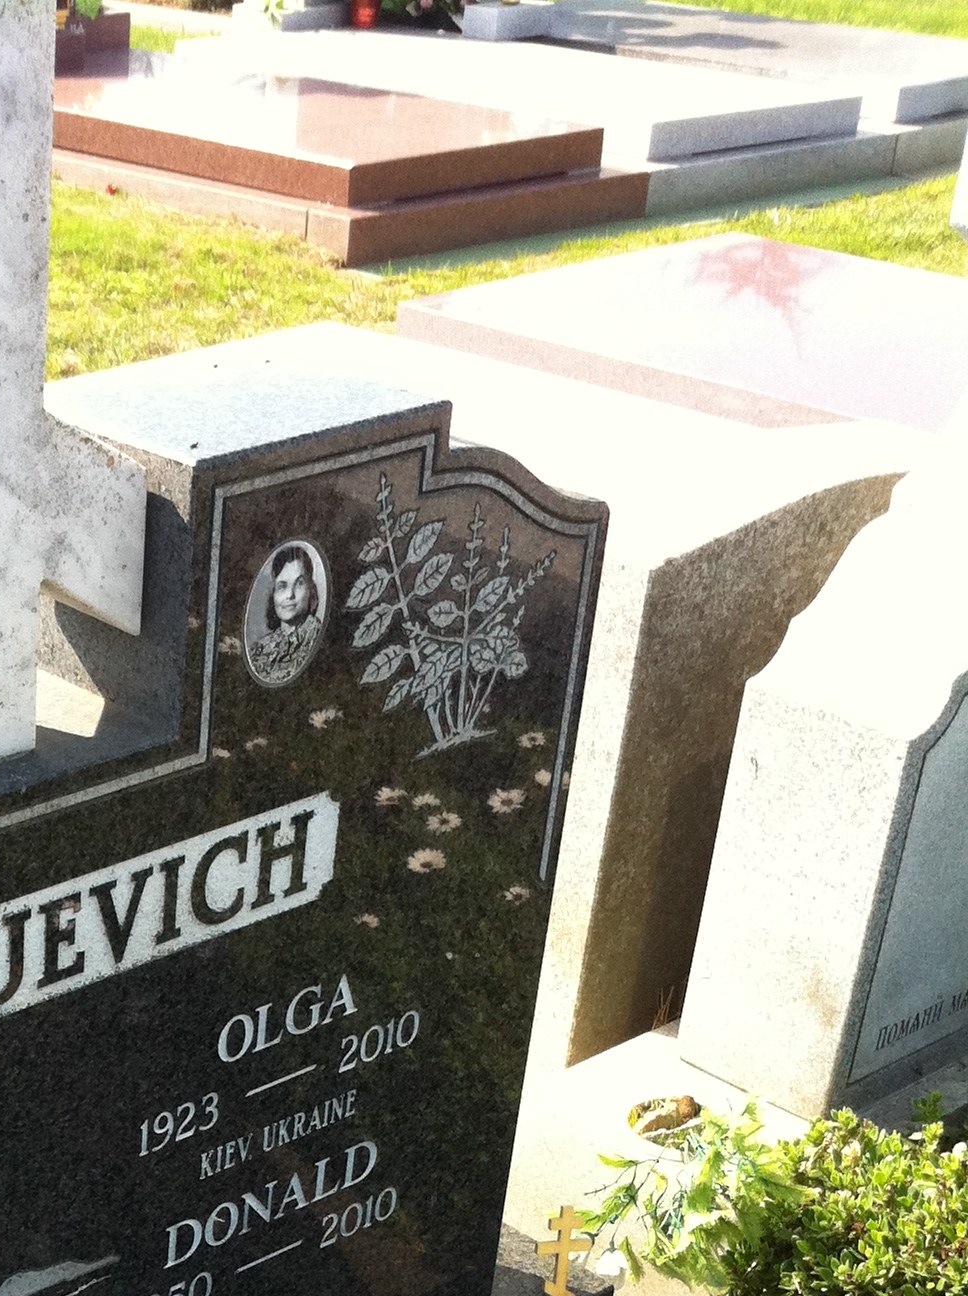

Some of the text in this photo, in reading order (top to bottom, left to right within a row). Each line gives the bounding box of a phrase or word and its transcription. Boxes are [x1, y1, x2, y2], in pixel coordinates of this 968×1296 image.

[216, 973, 358, 1064] OLGA
[138, 1092, 220, 1158] 1923
[337, 1010, 420, 1074] 2010
[263, 1089, 357, 1154] UKRAINE
[163, 1140, 378, 1269] DONALD
[319, 1186, 398, 1249] 2010
